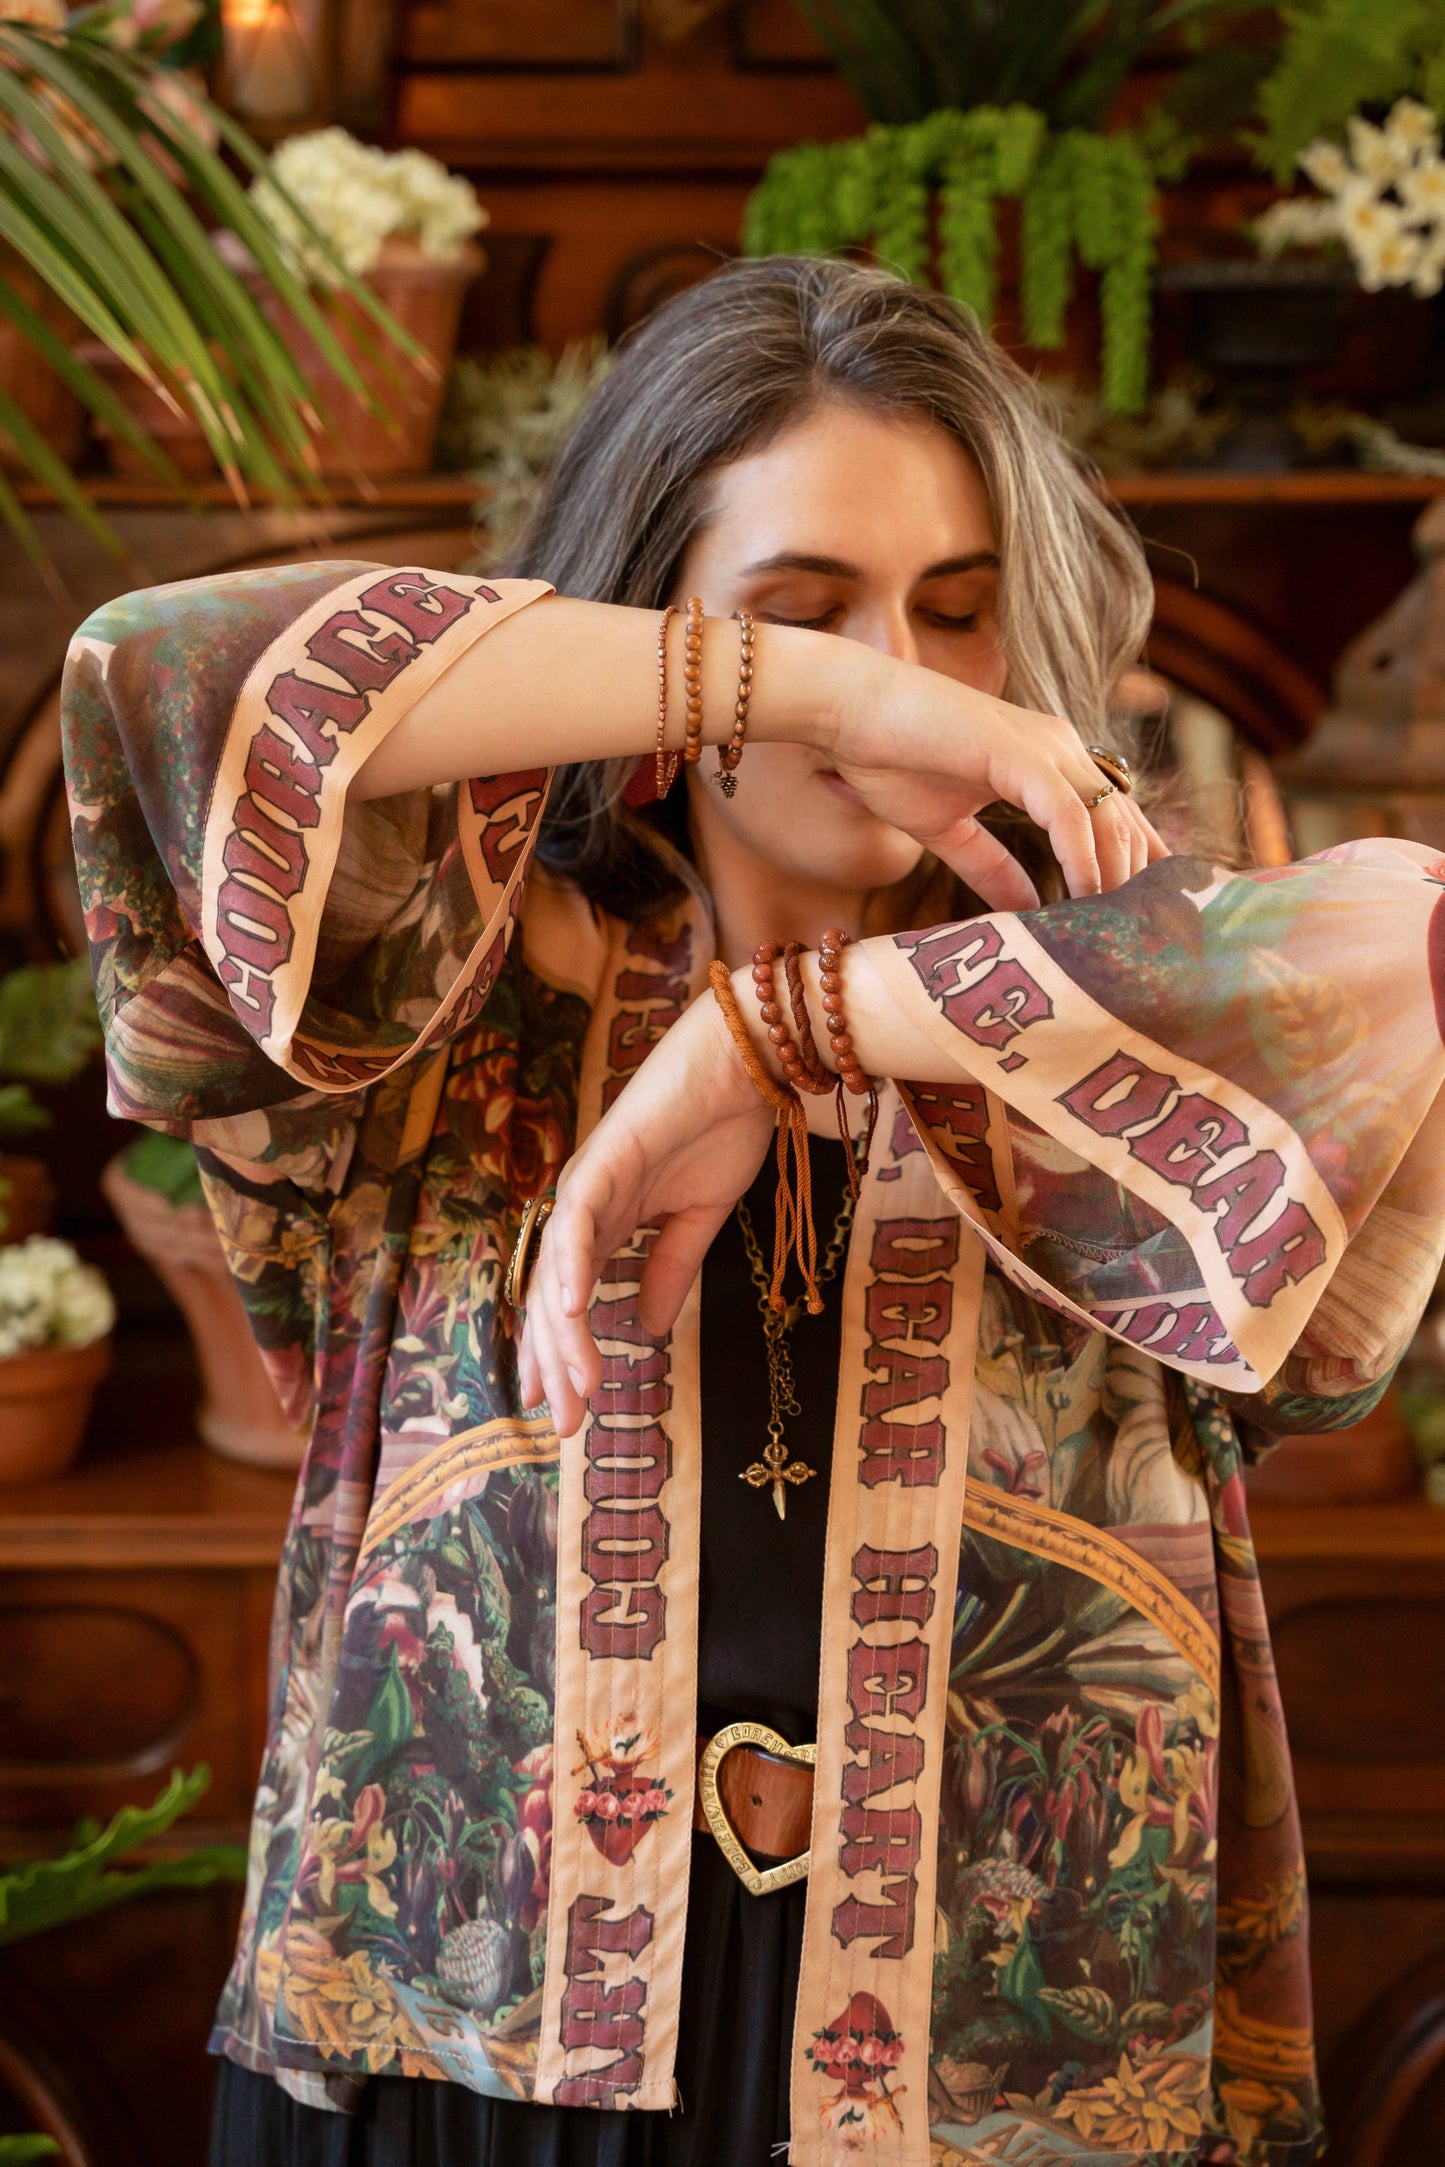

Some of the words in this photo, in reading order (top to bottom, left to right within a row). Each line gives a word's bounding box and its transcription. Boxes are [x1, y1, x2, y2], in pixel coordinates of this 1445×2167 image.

[1053, 1049, 1328, 1309] DEAR
[858, 1215, 961, 1490] DEAR
[831, 1542, 939, 1960] HEART
